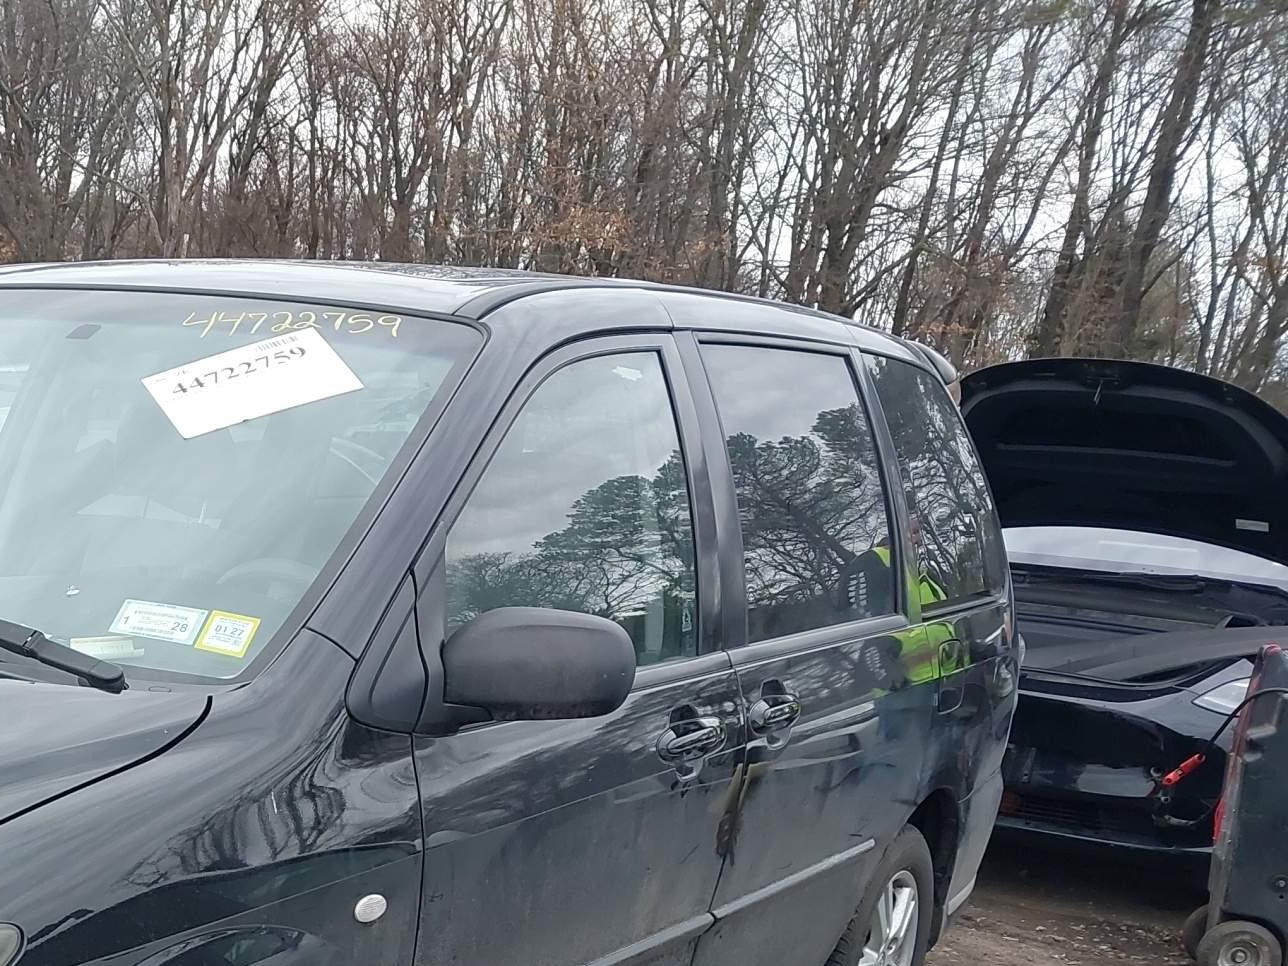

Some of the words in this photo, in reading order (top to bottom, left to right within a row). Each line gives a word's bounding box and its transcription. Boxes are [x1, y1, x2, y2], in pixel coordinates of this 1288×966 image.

[182, 311, 403, 338] 44722759
[172, 346, 307, 395] 44722759
[170, 620, 190, 634] 28
[231, 626, 246, 638] 27
